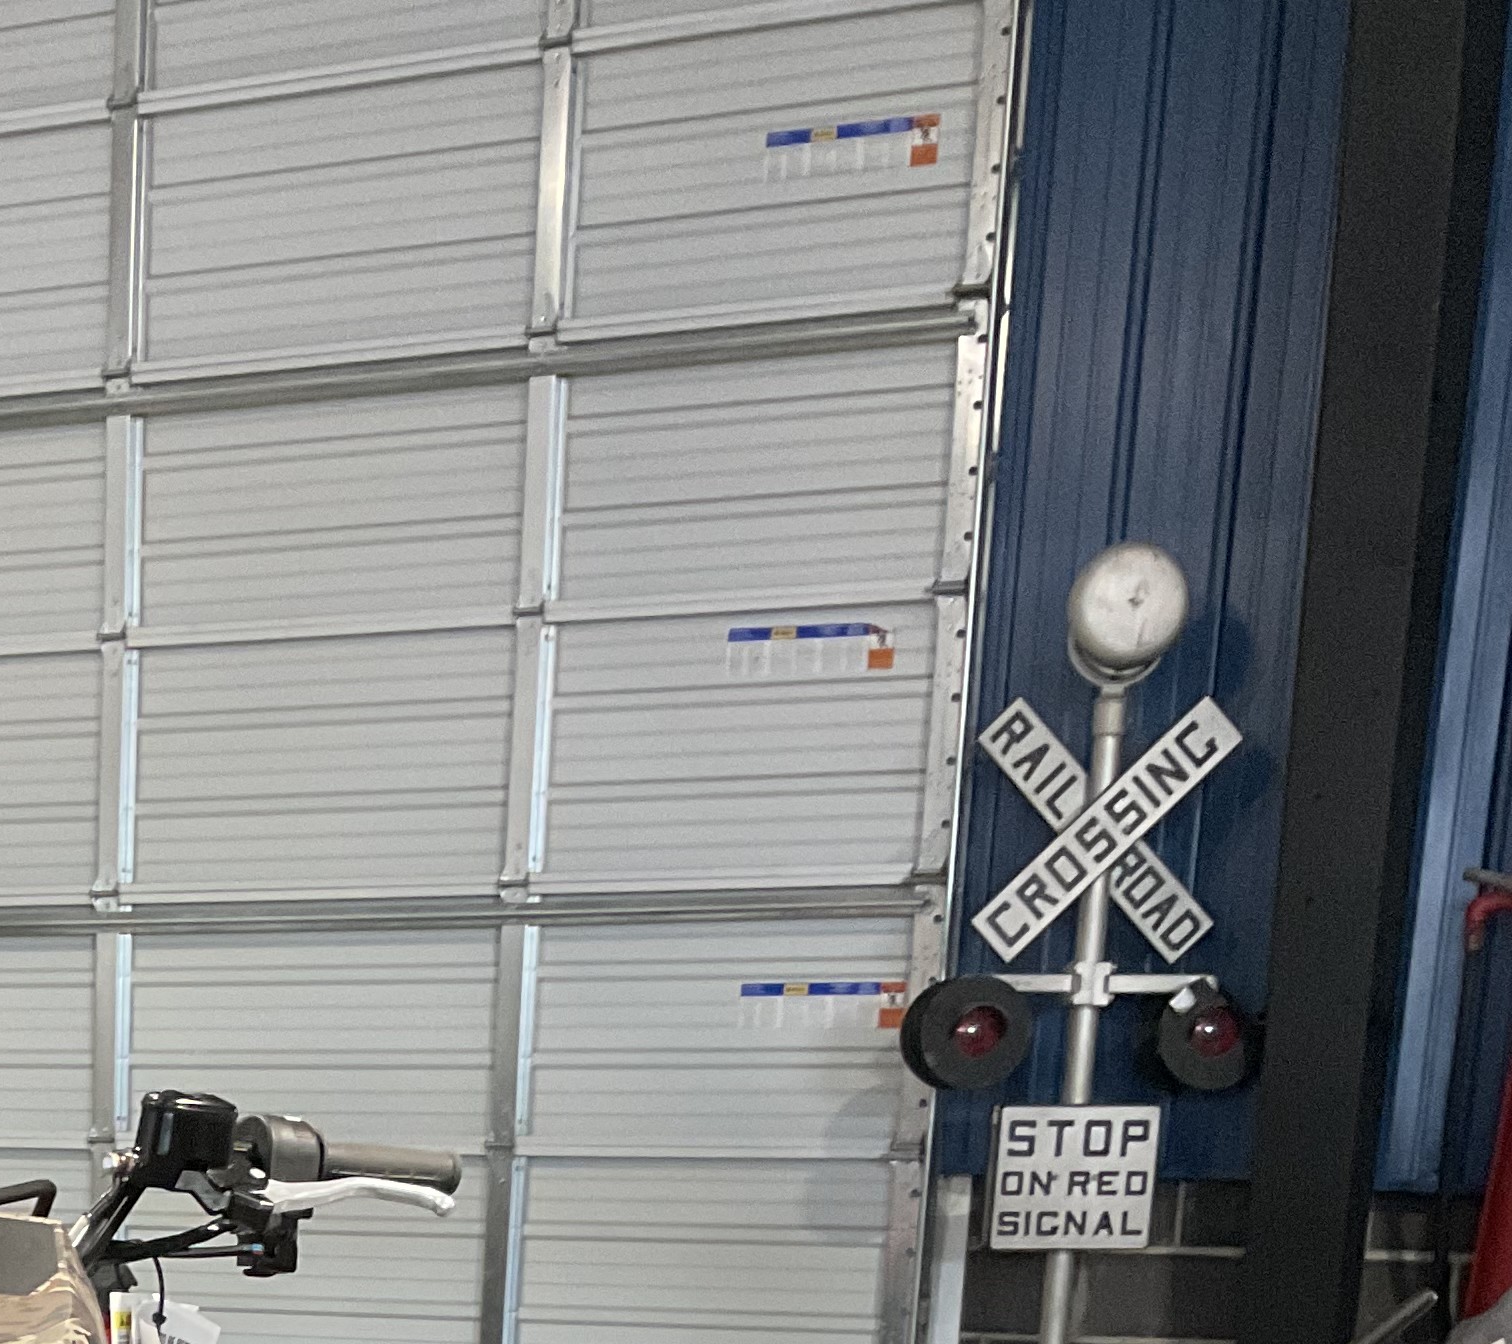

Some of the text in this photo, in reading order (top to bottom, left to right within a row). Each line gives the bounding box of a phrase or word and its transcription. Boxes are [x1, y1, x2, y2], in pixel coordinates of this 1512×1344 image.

[990, 710, 1078, 821] RAIL
[985, 720, 1220, 949] CROSSING
[1110, 846, 1201, 952] ROAD
[1007, 1119, 1150, 1158] STOP
[1000, 1170, 1148, 1197] ON RED
[996, 1210, 1143, 1237] SIGNAL
